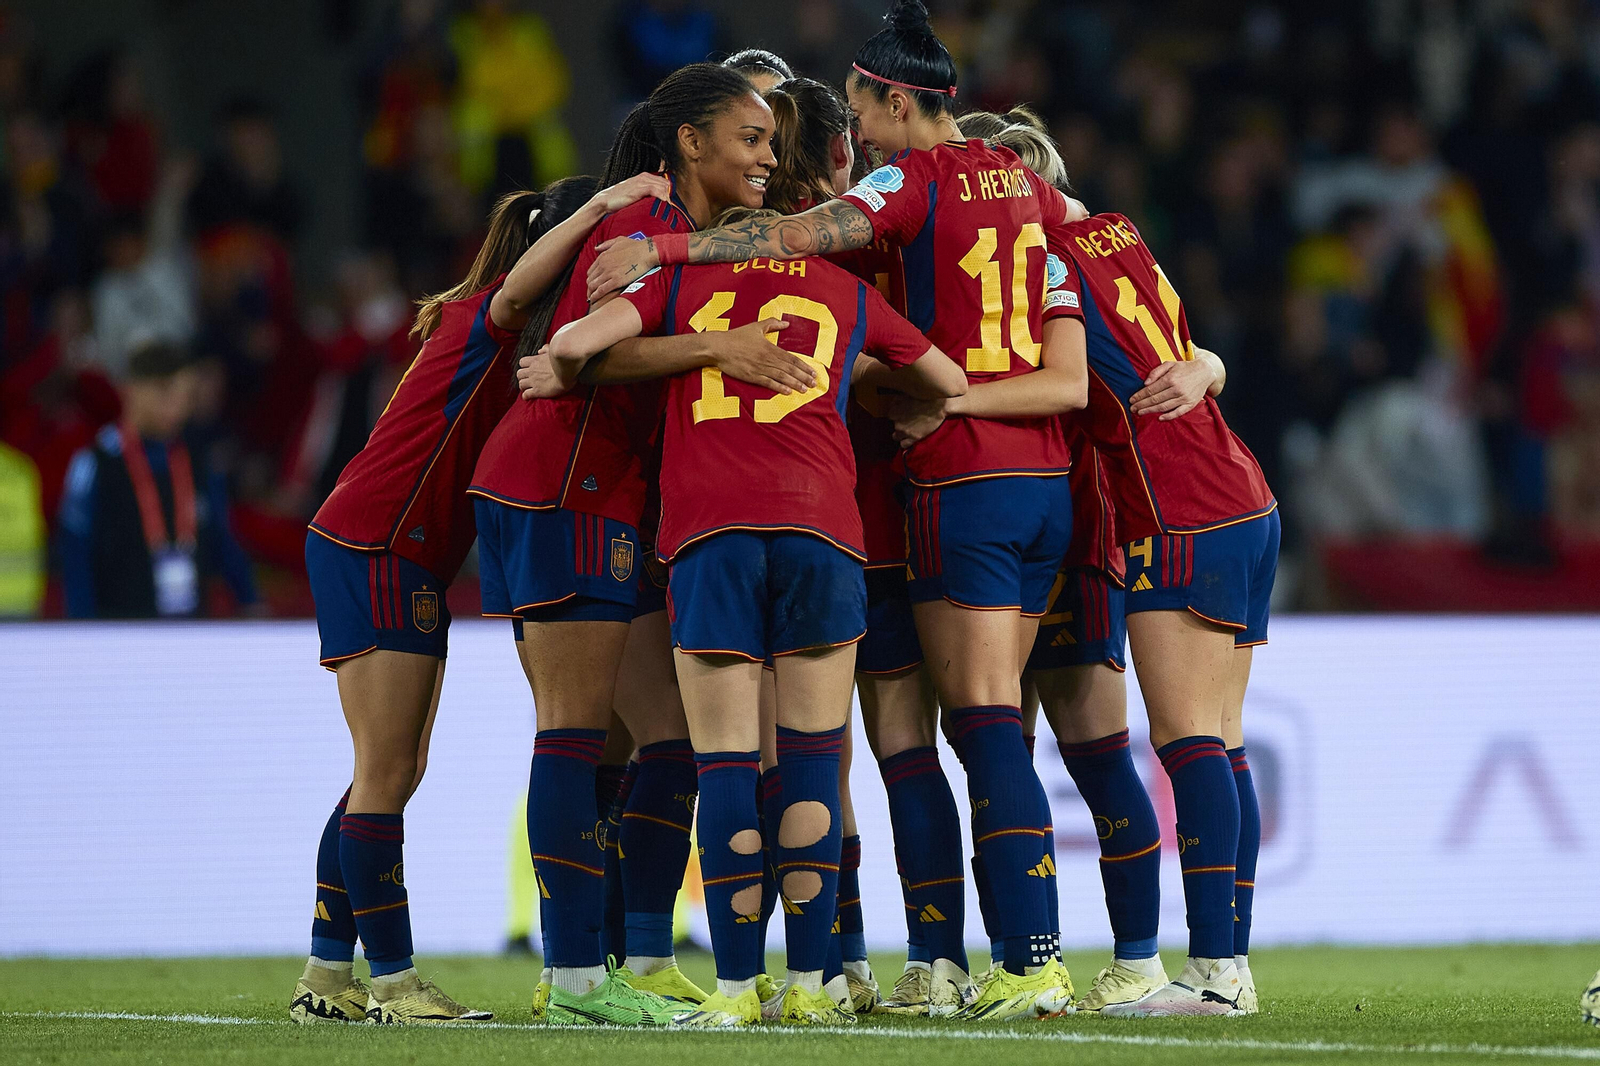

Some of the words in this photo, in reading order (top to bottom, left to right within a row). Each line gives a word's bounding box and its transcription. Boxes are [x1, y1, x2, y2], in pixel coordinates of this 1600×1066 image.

[958, 173, 976, 202] J.
[957, 222, 1047, 372] 10
[688, 291, 839, 425] 19
[1115, 817, 1129, 829] 09
